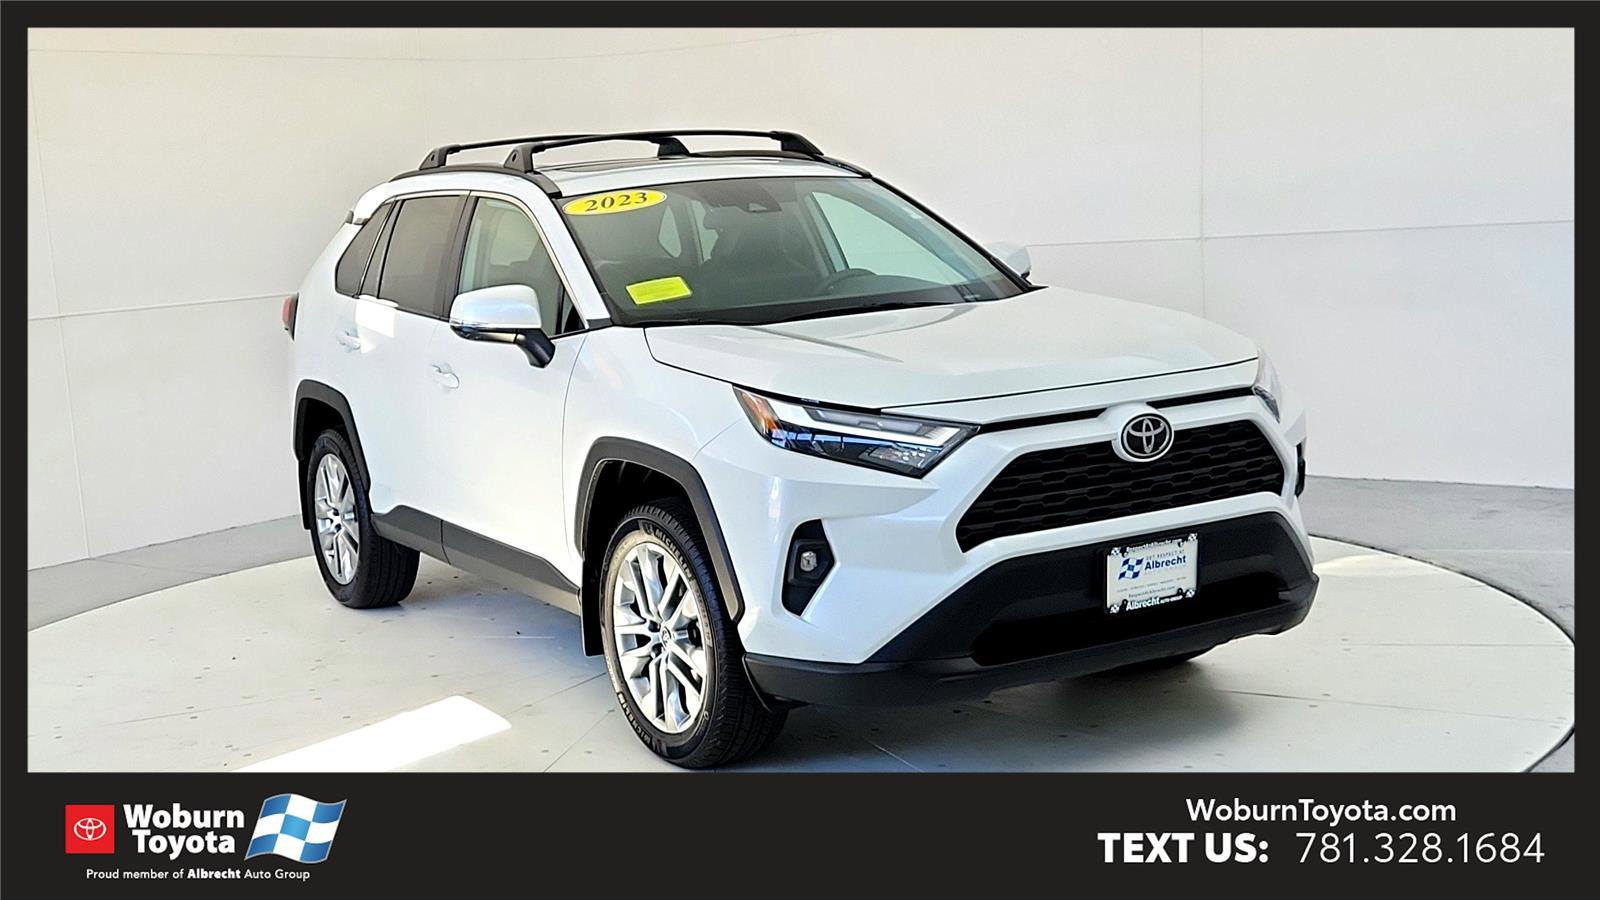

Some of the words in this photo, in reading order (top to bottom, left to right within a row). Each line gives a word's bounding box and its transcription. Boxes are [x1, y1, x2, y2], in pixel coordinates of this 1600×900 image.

[584, 192, 648, 212] 2023
[655, 529, 692, 578] MICHELIN
[1145, 555, 1186, 570] Albrecht
[1126, 596, 1160, 611] Albrecht
